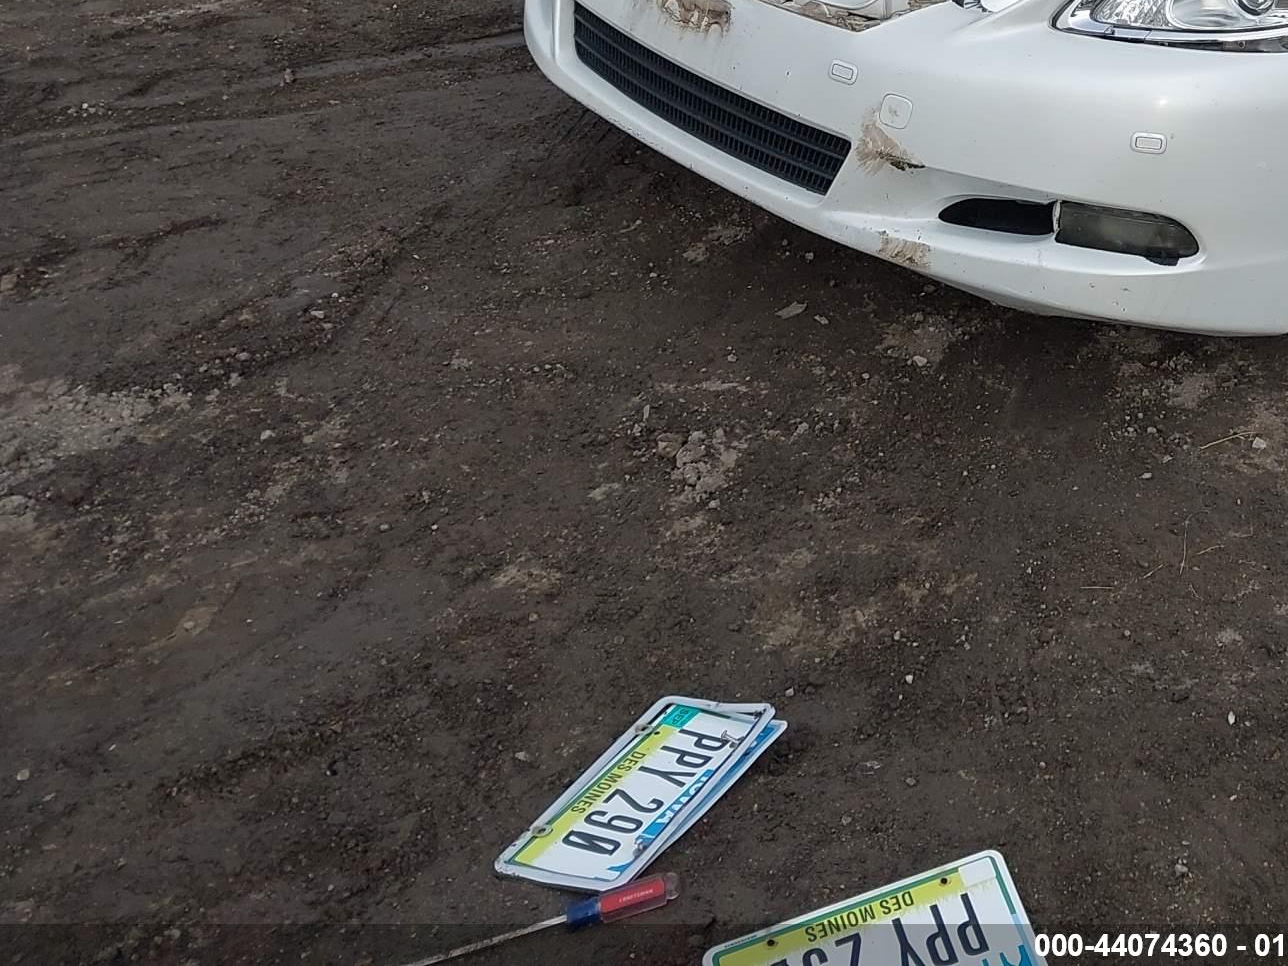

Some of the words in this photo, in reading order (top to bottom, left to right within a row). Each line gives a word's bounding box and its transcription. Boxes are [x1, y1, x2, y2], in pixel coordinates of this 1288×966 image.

[670, 708, 690, 725] SEP
[617, 751, 646, 772] DES
[638, 729, 725, 788] PPY
[571, 773, 624, 813] MOINES
[883, 891, 914, 915] DES
[805, 905, 875, 941] MOINES
[893, 893, 988, 966] PPY
